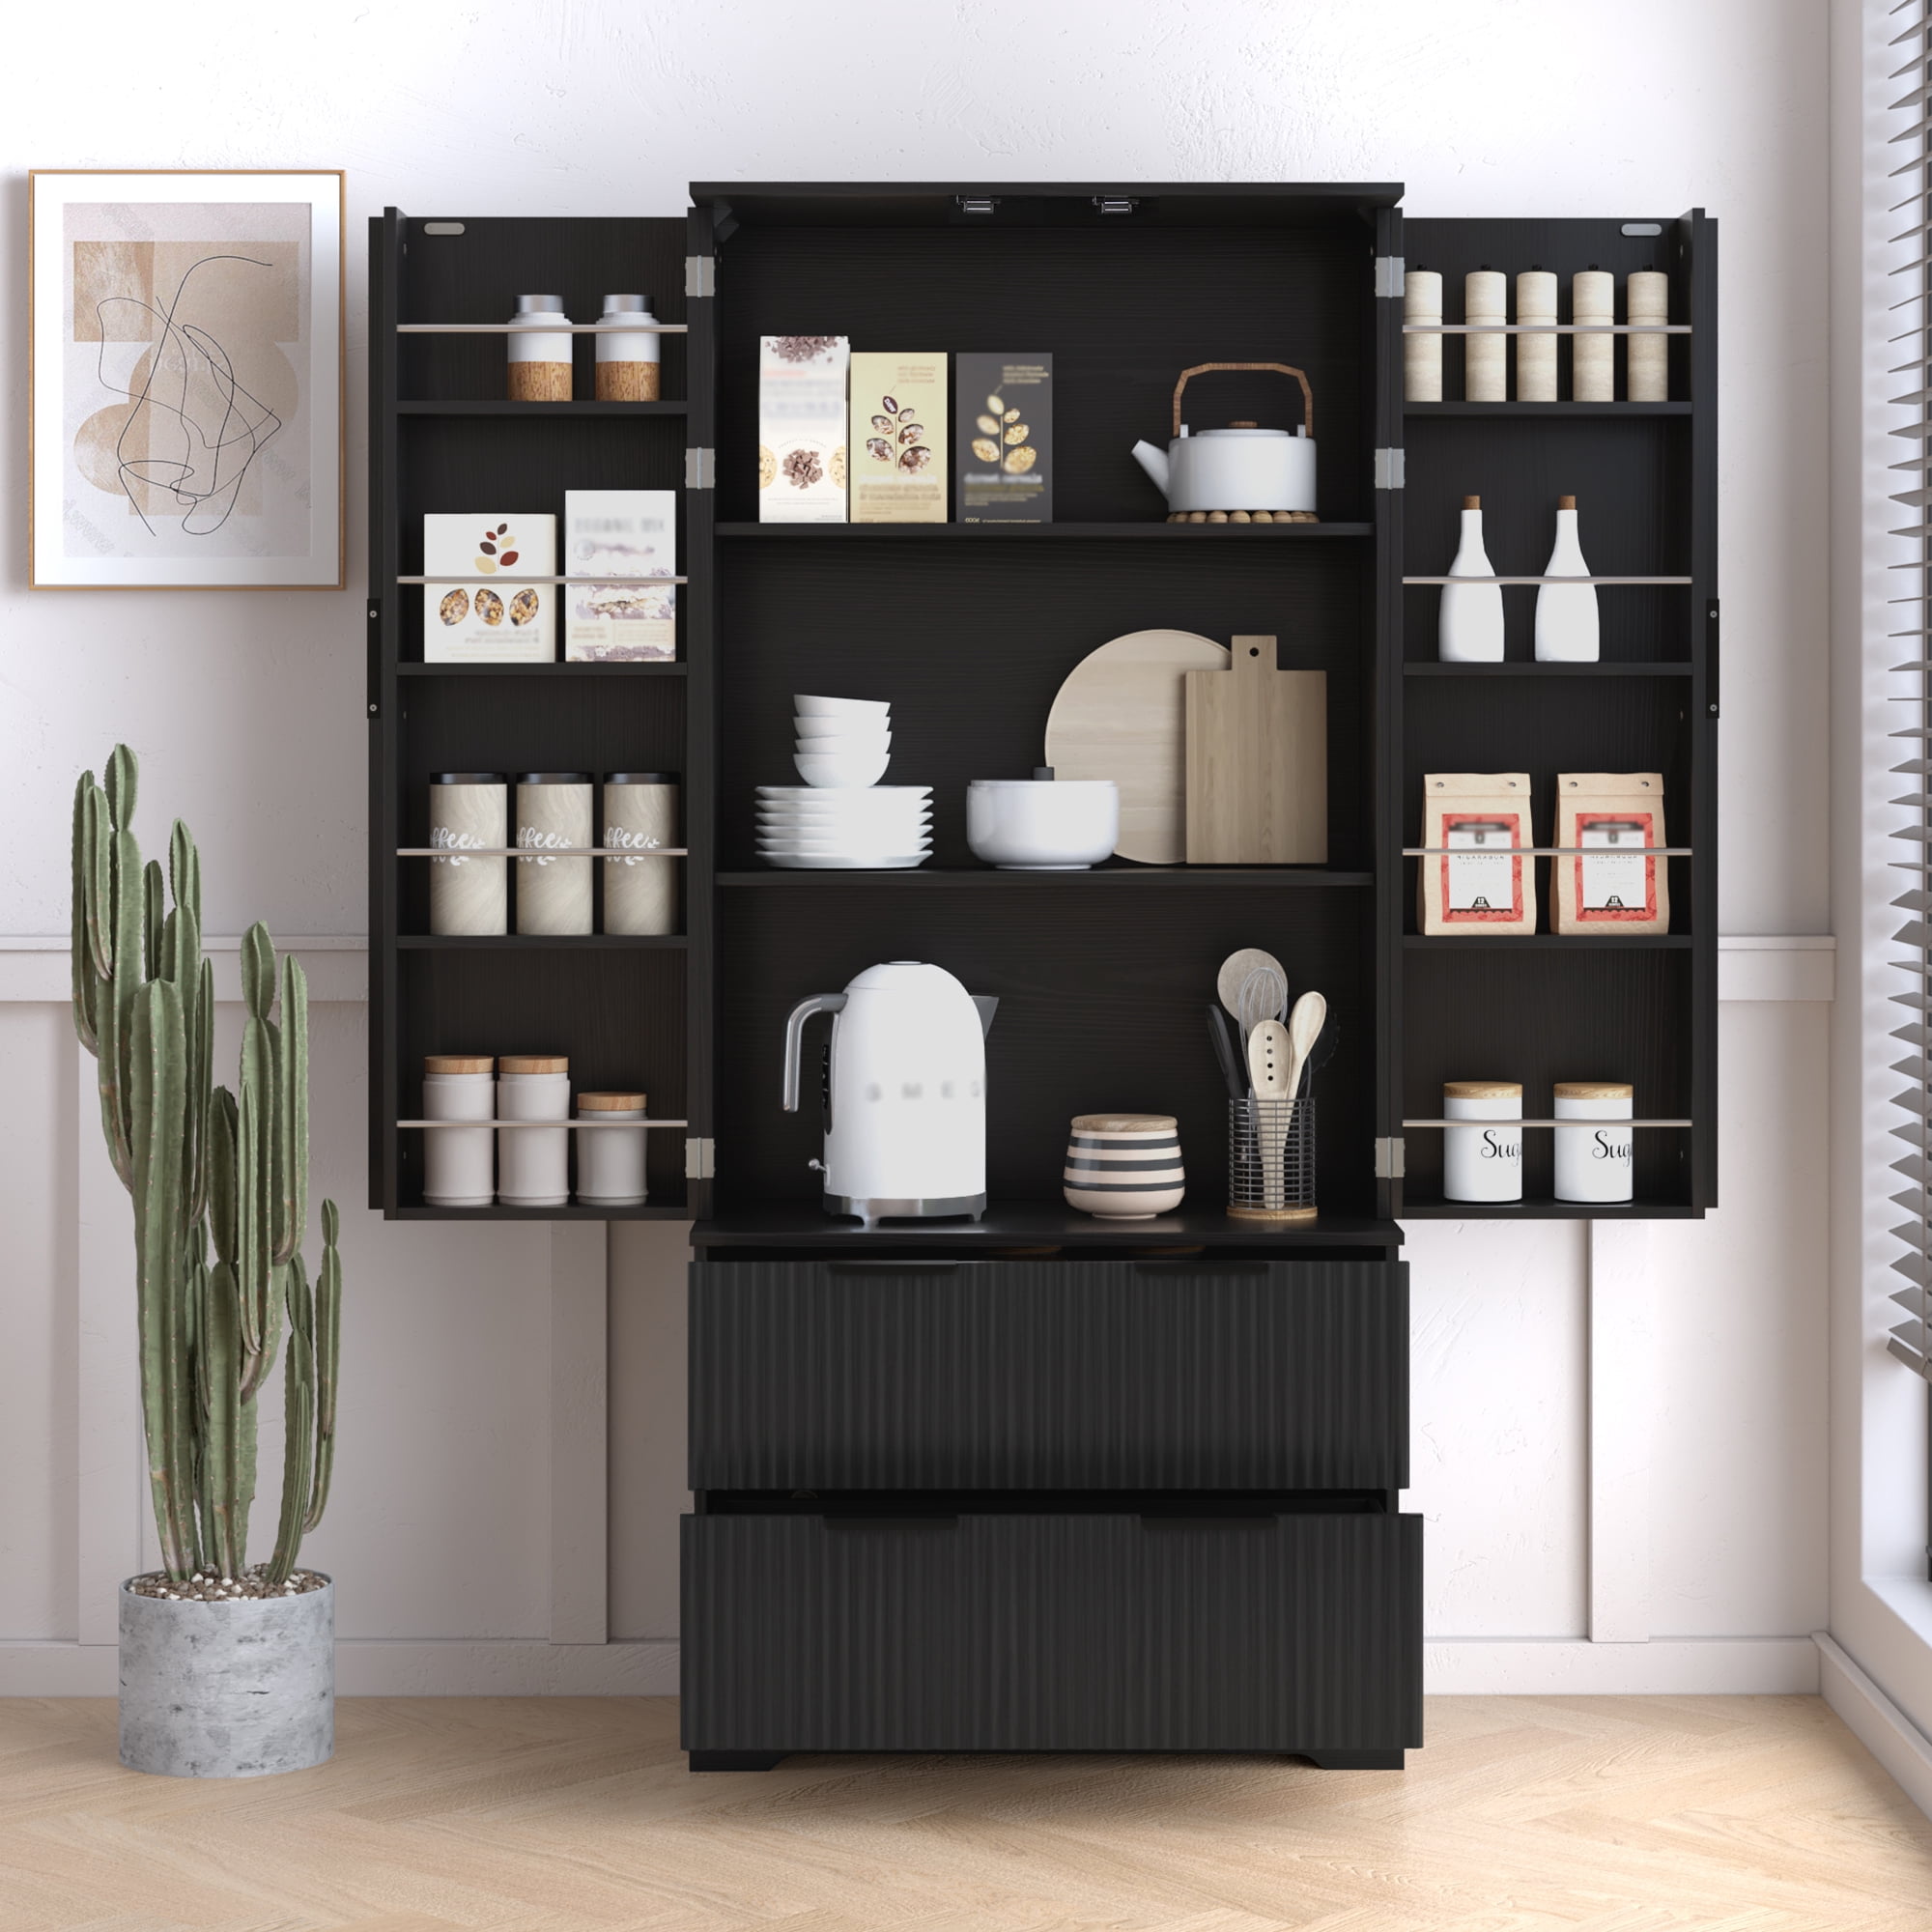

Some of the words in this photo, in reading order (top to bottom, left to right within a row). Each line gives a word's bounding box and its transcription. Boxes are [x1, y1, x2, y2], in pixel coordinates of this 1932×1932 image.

[431, 827, 474, 863] ffee
[517, 827, 561, 863] ffee
[604, 827, 649, 863] ffee
[1481, 1129, 1522, 1167] Sug
[1592, 1129, 1634, 1167] Sug
